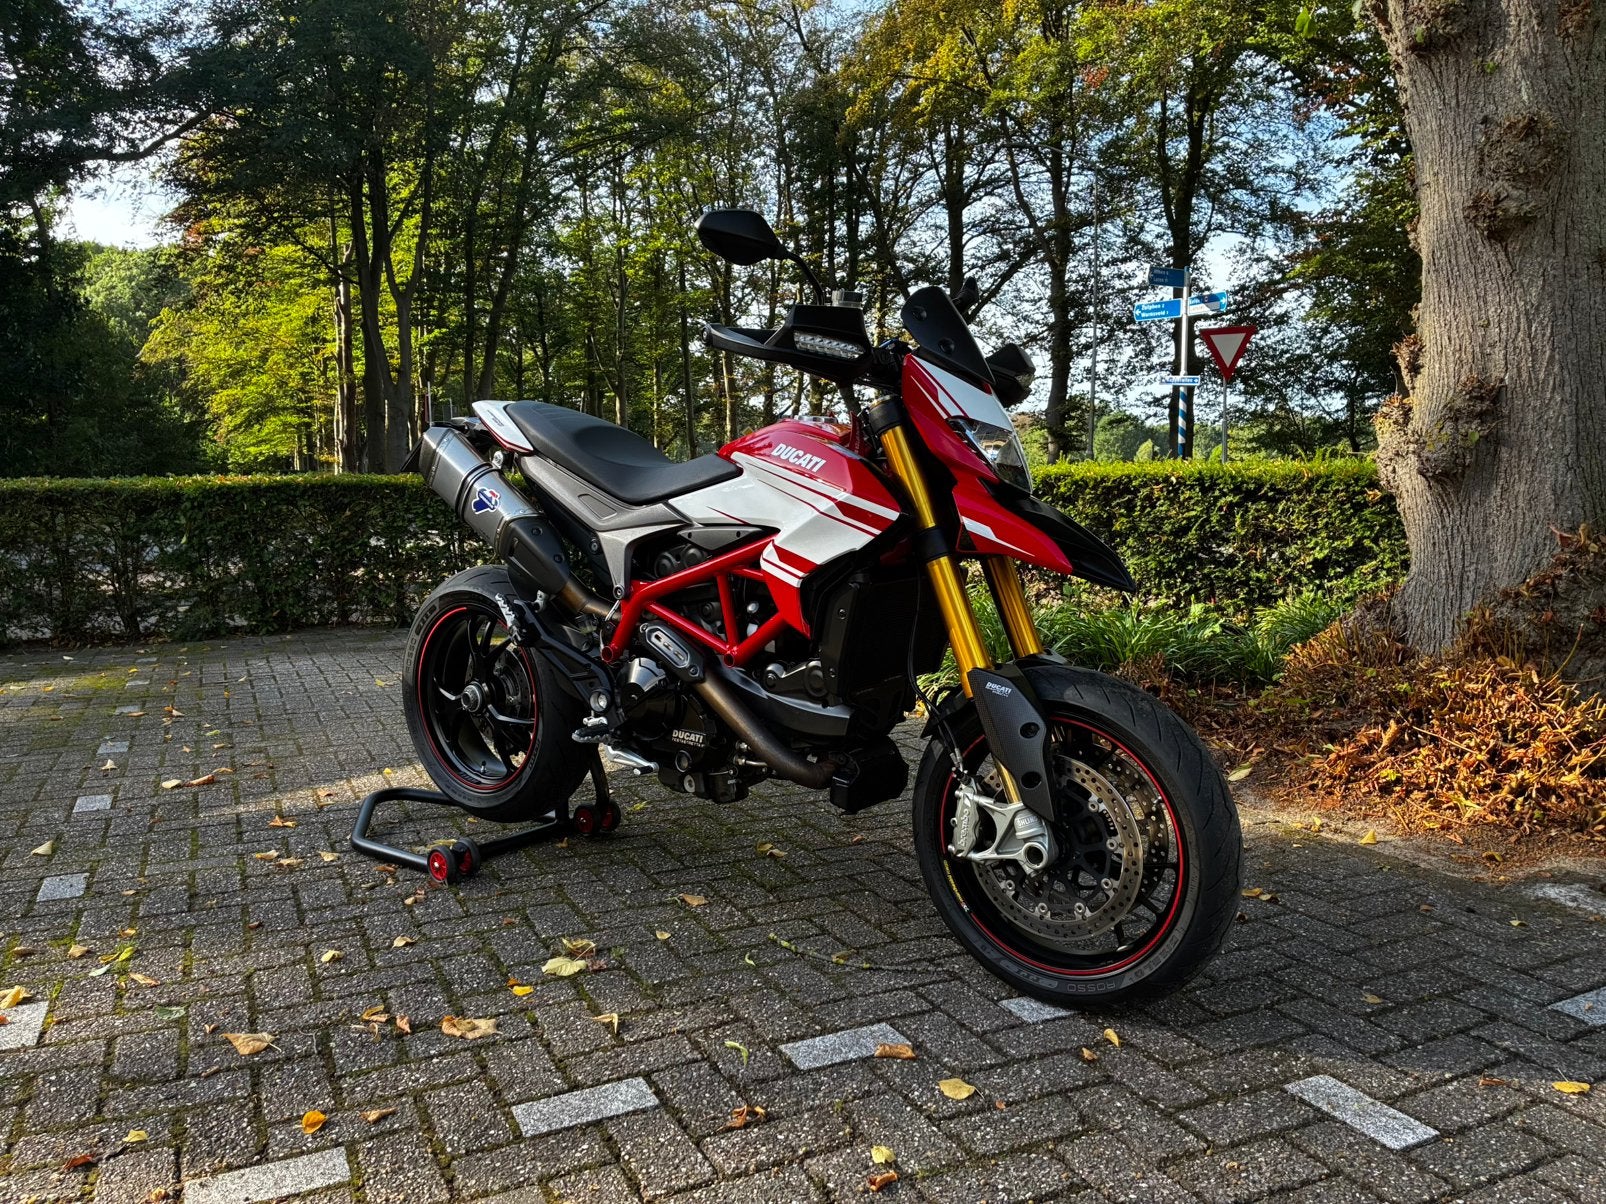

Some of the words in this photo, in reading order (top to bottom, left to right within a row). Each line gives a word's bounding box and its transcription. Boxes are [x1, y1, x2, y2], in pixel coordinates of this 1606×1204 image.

[771, 443, 827, 473] DUCATI
[985, 681, 1012, 694] DUCATI
[672, 729, 704, 743] DUCATI
[1066, 981, 1116, 993] ROSSO
